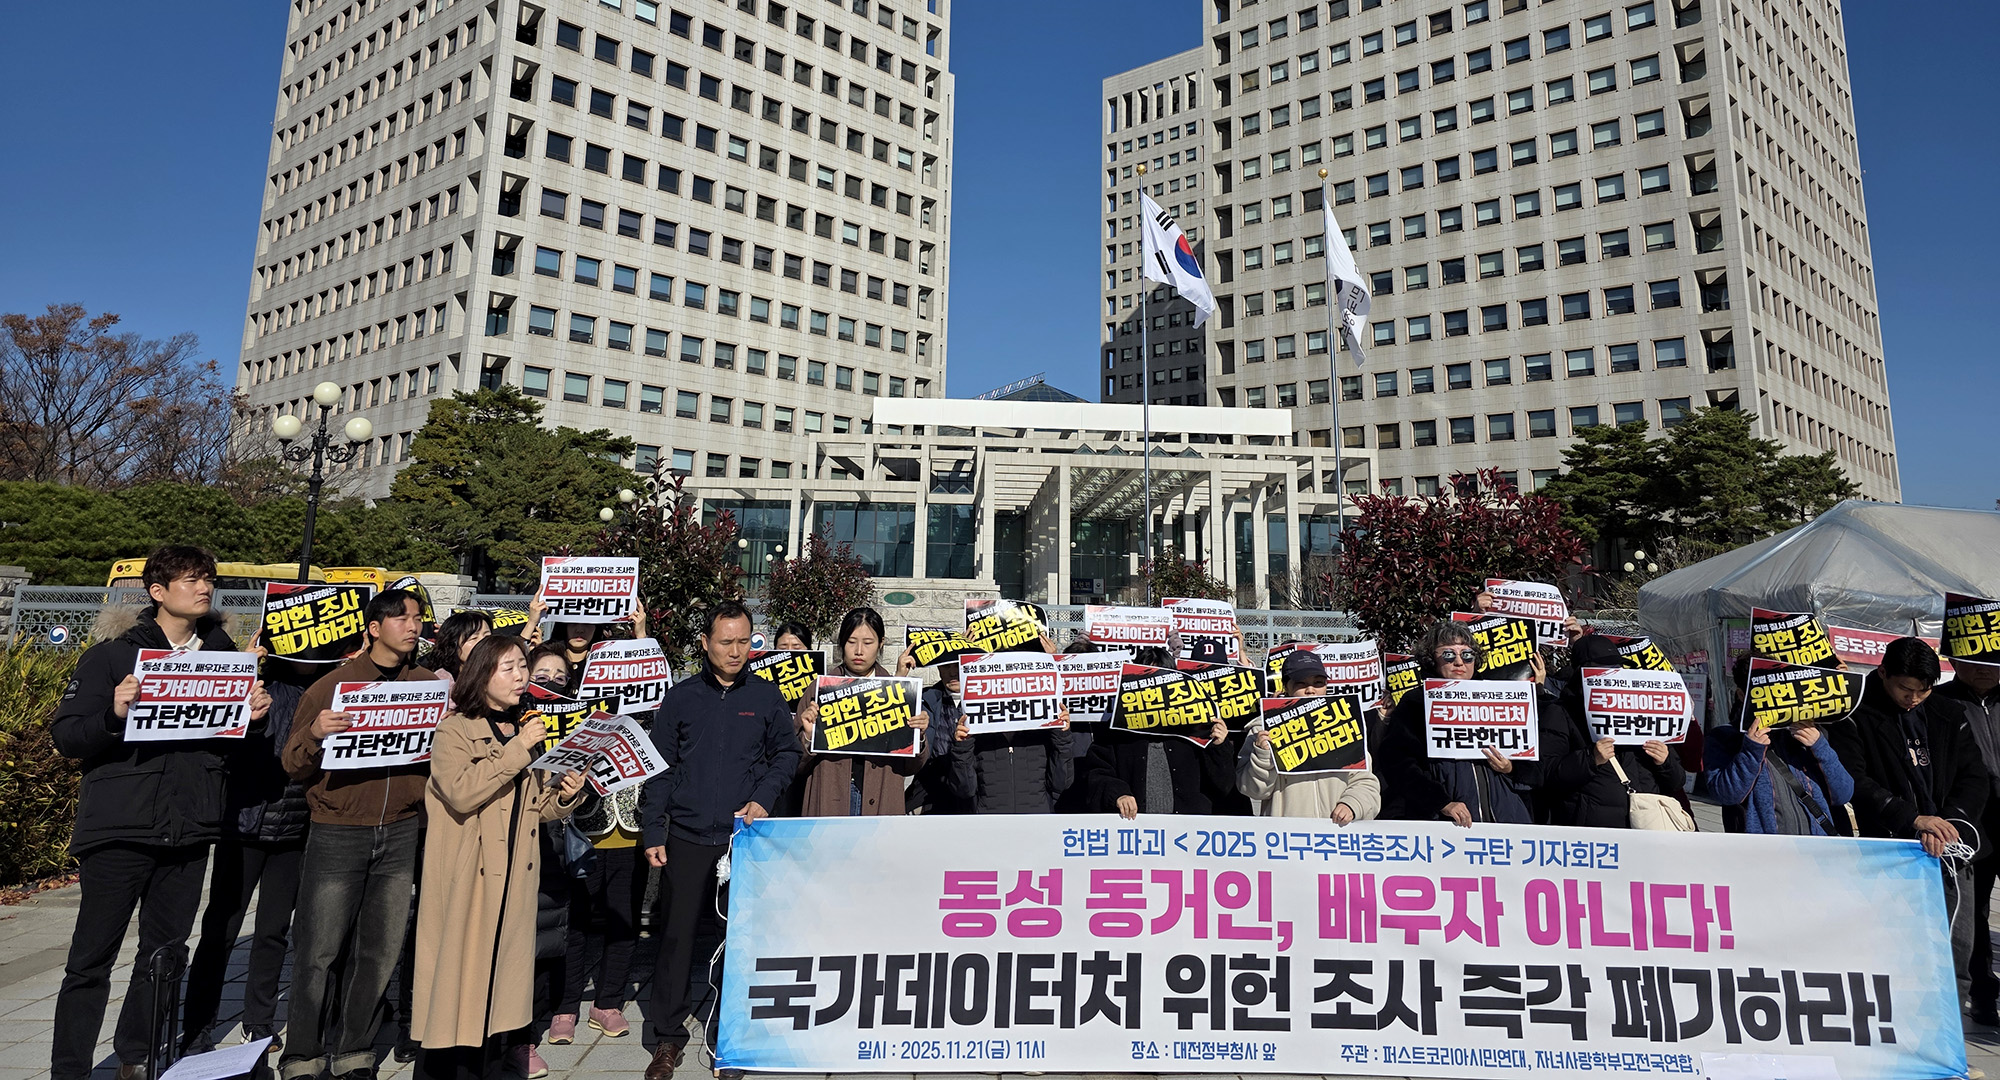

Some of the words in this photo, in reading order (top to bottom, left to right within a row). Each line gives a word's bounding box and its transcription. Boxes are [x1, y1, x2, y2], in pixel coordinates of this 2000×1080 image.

[549, 579, 630, 593] 국가데이터처
[1524, 591, 1547, 599] 배우자로
[267, 600, 284, 611] 헌법
[284, 596, 303, 607] 질서
[304, 587, 337, 602] 파괴하는
[546, 597, 630, 616] 규탄한다!
[1492, 600, 1563, 617] 국가데이터처
[1974, 602, 2000, 612] 파괴하
[266, 604, 314, 634] 위헌
[317, 589, 360, 621] 조사
[270, 611, 365, 655] 폐기하라!
[968, 616, 1002, 639] 위헌
[1092, 625, 1167, 641] 국가데이터처
[1482, 618, 1507, 630] 파괴하는
[1754, 624, 1768, 632] 헌법
[1769, 623, 1786, 631] 질서
[1947, 614, 1986, 636] 위헌
[909, 631, 947, 646] 위헌
[1473, 632, 1490, 650] 헌
[1492, 621, 1528, 646] 조사
[1754, 629, 1796, 653] 위헌
[600, 651, 622, 659] 동거인,
[624, 649, 650, 658] 배우자로
[764, 652, 791, 667] 파괴하는
[1204, 644, 1213, 655] D
[1340, 652, 1366, 660] 배우자로
[142, 662, 161, 672] 동성
[163, 663, 192, 672] 동거인,
[195, 664, 230, 672] 배우자로
[232, 664, 255, 673] 조사한
[587, 660, 666, 680] 국가데이터처
[776, 654, 814, 683] 조사
[963, 665, 977, 673] 동성
[979, 664, 1004, 672] 동거인,
[1208, 667, 1235, 679] 파괴하는
[1326, 662, 1378, 680] 데이터처
[1751, 676, 1767, 685] 헌법
[1768, 673, 1785, 683] 질서
[1786, 668, 1821, 681] 파괴하는
[142, 679, 249, 698] 국가데이터처
[967, 675, 1055, 695] 국가데이터처
[1123, 680, 1138, 691] 헌법
[1139, 677, 1155, 687] 질서
[1156, 673, 1184, 684] 파괴하는
[1219, 670, 1256, 698] 조사
[1387, 670, 1418, 690] 위헌
[1586, 678, 1601, 686] 동성
[1604, 679, 1630, 688] 동거인,
[1632, 680, 1661, 689] 배우자로
[1663, 681, 1683, 690] 조사한
[341, 694, 359, 703] 동성
[361, 694, 388, 703] 동거인,
[391, 693, 422, 702] 배우자로
[424, 692, 446, 700] 조사한
[819, 691, 835, 703] 헌법
[835, 687, 851, 698] 질서
[852, 681, 882, 694] 파괴하는
[1121, 689, 1165, 712] 위헌
[1167, 680, 1206, 706] 조사
[1428, 691, 1442, 699] 동성
[1445, 691, 1471, 700] 동거인,
[1505, 691, 1528, 700] 조사한
[1751, 682, 1798, 708] 위헌
[1800, 674, 1849, 702] 조사
[553, 702, 588, 713] 파괴하는
[820, 696, 861, 726] 위헌
[864, 683, 906, 713] 조사
[1592, 692, 1683, 711] 국가데이터처
[134, 704, 244, 729] 규탄한다!
[966, 700, 1058, 724] 규탄한다!
[1124, 701, 1215, 729] 폐기하라!
[1265, 717, 1281, 727] 헌법
[1282, 710, 1297, 721] 질서
[1298, 698, 1327, 715] 파괴하는
[1433, 706, 1525, 721] 국가데이터처
[1754, 696, 1851, 730] 폐기하라!
[540, 714, 559, 737] 헌
[824, 705, 911, 750] 폐기하라!
[1268, 716, 1310, 748] 위헌
[1310, 698, 1352, 733] 조사
[1591, 715, 1684, 736] 규탄한다!
[332, 731, 435, 758] 규탄한다!
[1278, 720, 1363, 772] 폐기하라!
[1432, 727, 1529, 749] 규탄한다!
[636, 748, 656, 772] 조사한
[1063, 829, 1110, 858] 헌법
[1116, 829, 1166, 858] 파괴
[1196, 832, 1257, 858] 2025
[1266, 833, 1434, 863] 인구주택총조사
[1464, 837, 1512, 865] 규탄
[1522, 839, 1619, 870] 기자회견
[939, 868, 1063, 939] 동성
[1086, 869, 1294, 952] 동거인,
[1318, 874, 1503, 947] 배우자
[1525, 878, 1735, 953] 아니다!
[748, 951, 1141, 1031] 국가데이터처
[1163, 953, 1292, 1032] 위헌
[1311, 960, 1442, 1036] 조사
[1459, 965, 1593, 1040] 즉각
[1606, 967, 1896, 1046] 폐기하라!
[858, 1040, 886, 1060] 일시
[901, 1040, 1011, 1060] 2025.11.21(금)
[1017, 1040, 1045, 1059] 11시
[1132, 1041, 1159, 1060] 장소
[1173, 1041, 1258, 1060] 대전정부청사
[1263, 1043, 1276, 1061] 앞
[1341, 1044, 1369, 1063] 주관
[1383, 1046, 1532, 1071] 퍼스트코리아시민연대,
[1536, 1050, 1700, 1075] 자녀사랑학부모전국연합,
